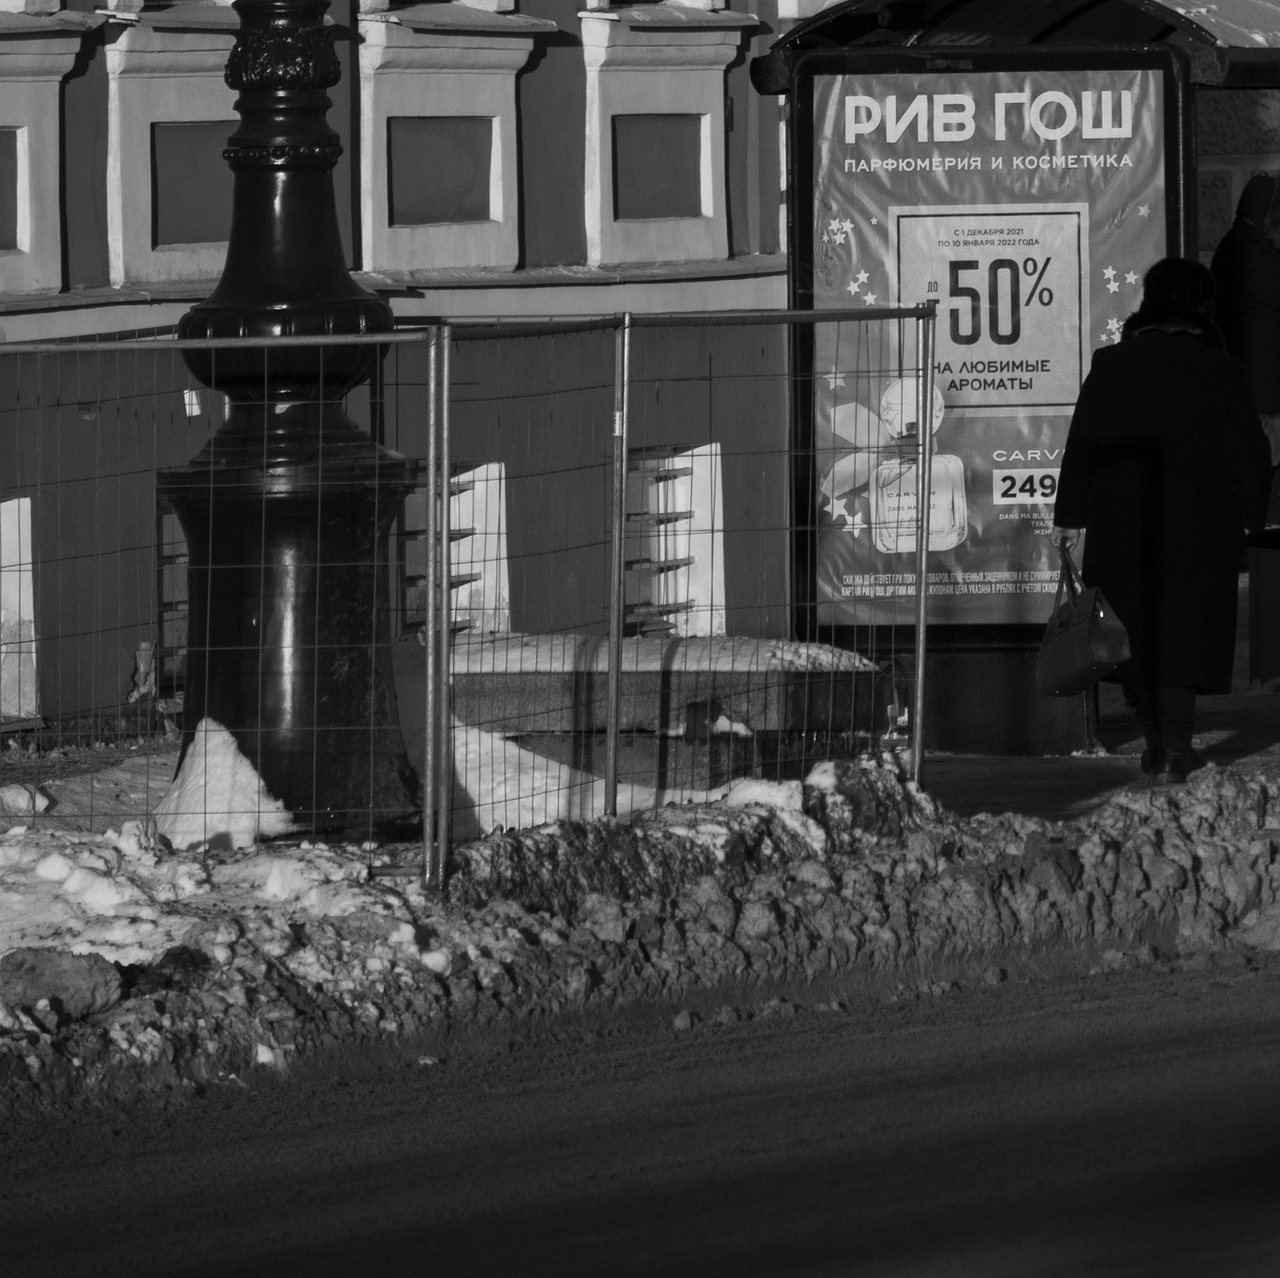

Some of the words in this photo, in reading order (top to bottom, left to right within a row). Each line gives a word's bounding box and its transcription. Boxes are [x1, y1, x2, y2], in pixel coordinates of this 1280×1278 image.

[844, 93, 976, 144] РИВ
[994, 89, 1133, 142] ГОШ
[844, 156, 982, 173] ПАРФЮМЕРИЯ
[991, 156, 1003, 171] И
[1012, 154, 1133, 171] КОСМЕТИКА
[953, 229, 960, 237] С
[966, 228, 1005, 237] ДЕКАБРЯ
[938, 240, 950, 248] ПО
[962, 239, 995, 247] ЯНВАРЯ
[1018, 239, 1040, 247] ГОДА
[927, 281, 939, 293] ДО
[959, 359, 1051, 374] ЛЮБИМЫЕ
[947, 377, 1033, 391] АРОМАТЫ
[992, 449, 1065, 462] CARV
